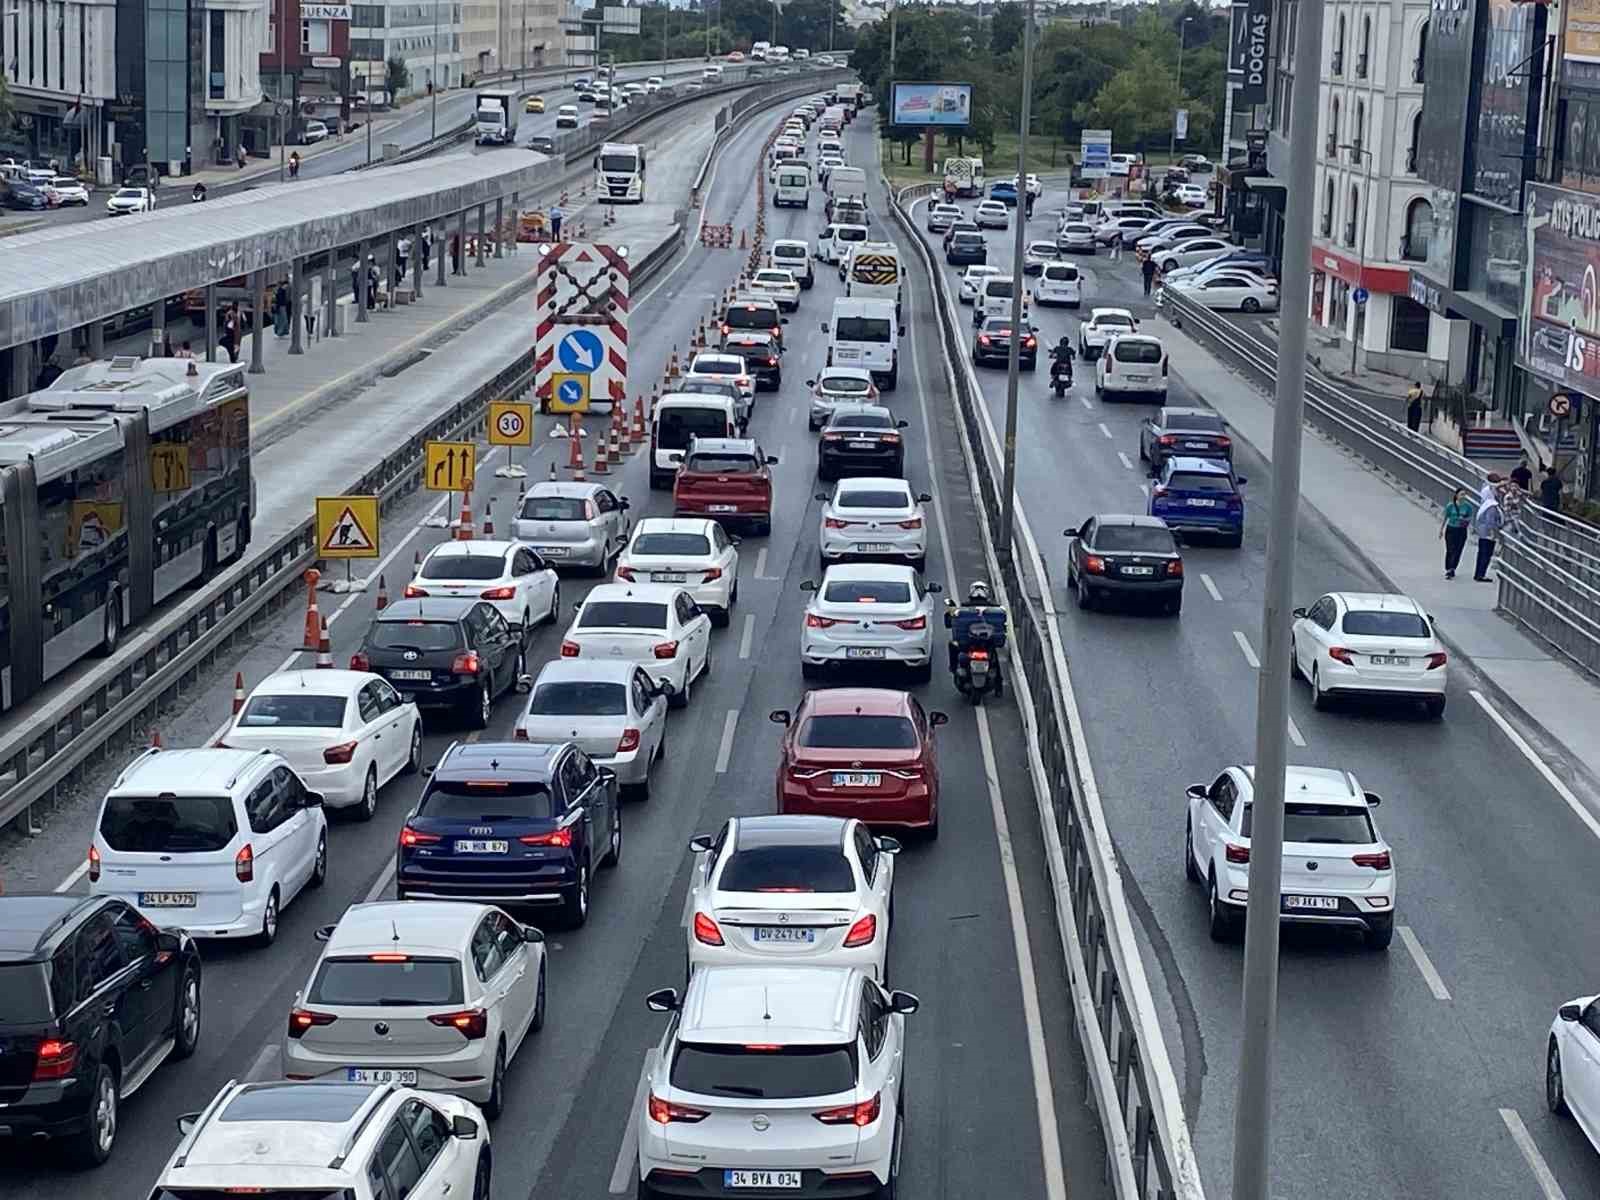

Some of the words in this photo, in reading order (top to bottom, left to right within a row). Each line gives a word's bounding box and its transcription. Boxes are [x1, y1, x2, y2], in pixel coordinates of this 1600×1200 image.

[502, 417, 519, 431] 30
[356, 1071, 368, 1082] 34
[734, 1172, 746, 1185] 34
[752, 1172, 772, 1185] BYA
[778, 1173, 798, 1186] 034
